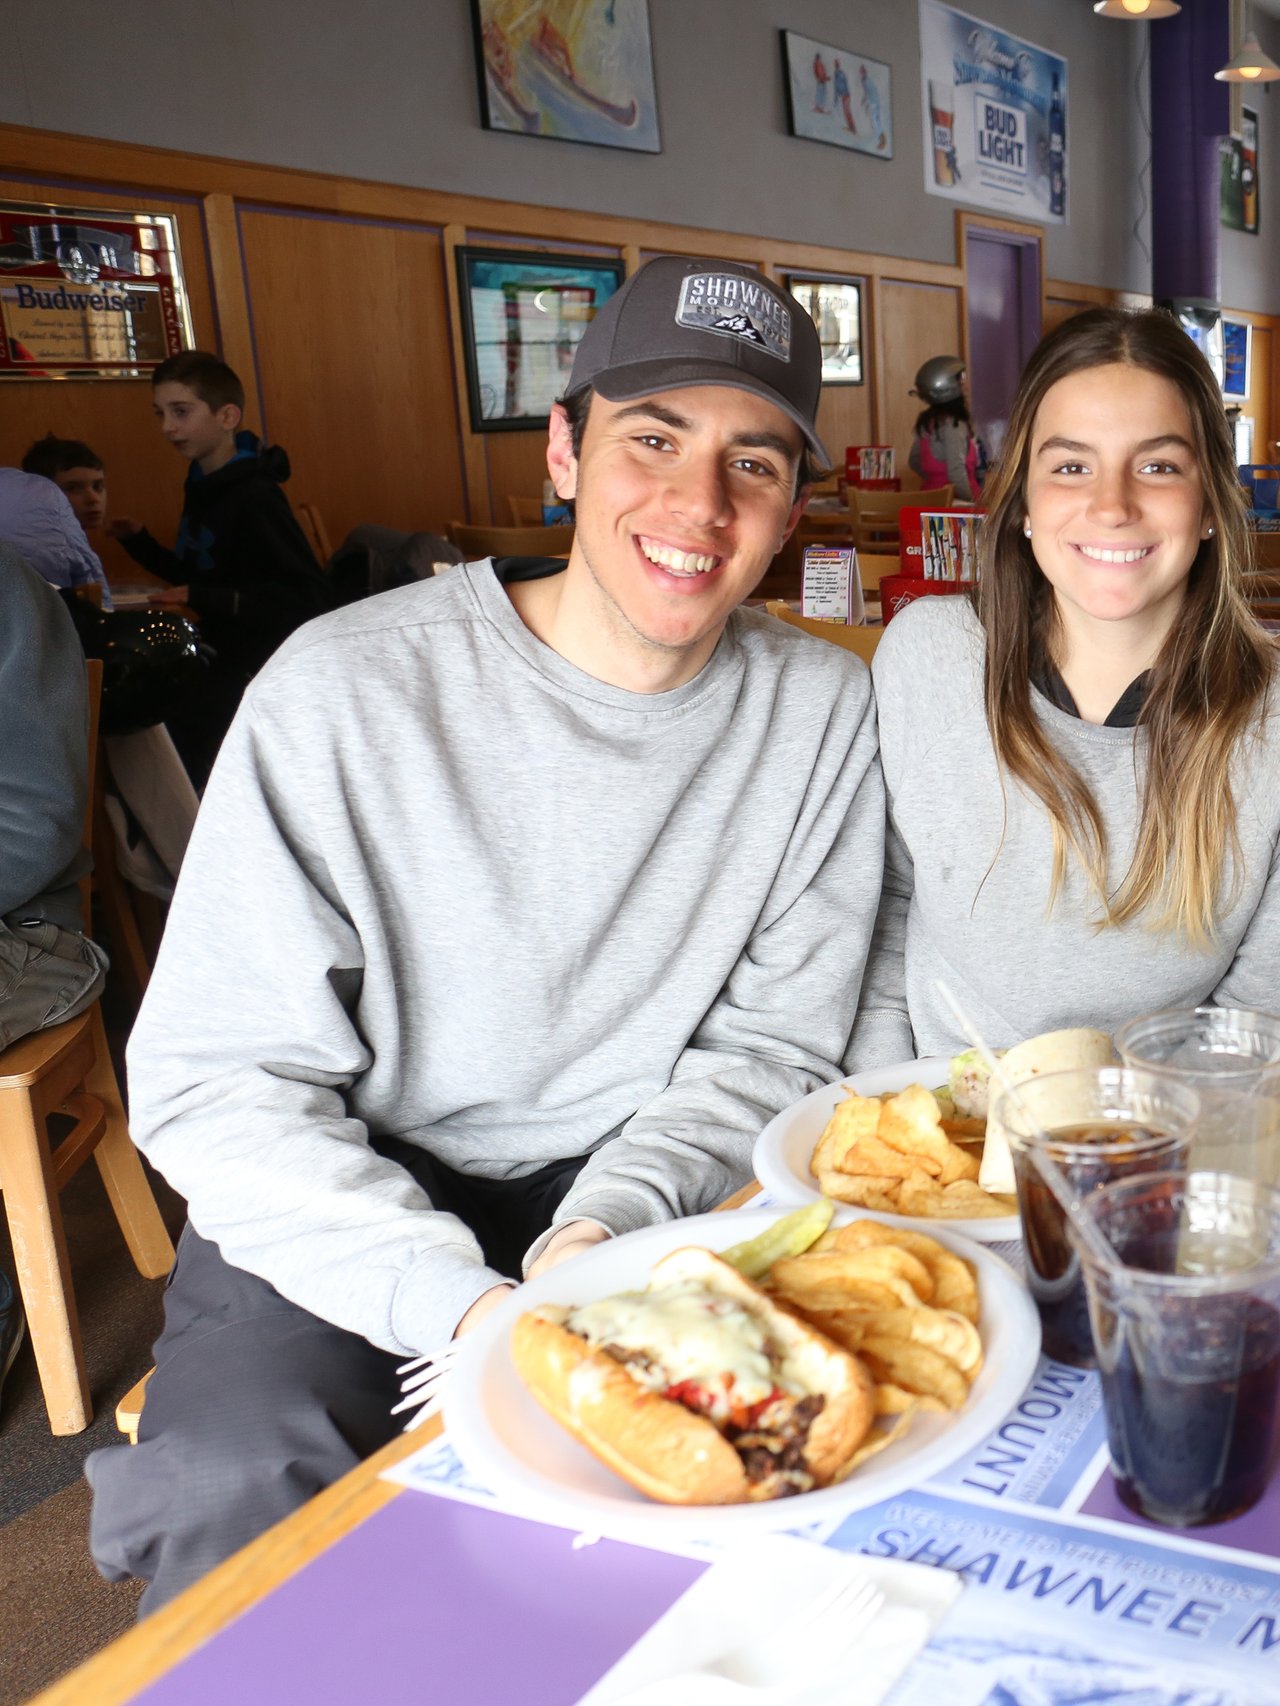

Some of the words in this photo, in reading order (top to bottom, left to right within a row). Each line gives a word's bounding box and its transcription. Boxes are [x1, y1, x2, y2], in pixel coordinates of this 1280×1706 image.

[985, 104, 1017, 137] BUD
[979, 130, 1024, 167] LIGHT
[15, 284, 147, 313] Budweiser
[691, 277, 789, 333] SHAWNEE
[885, 1504, 1025, 1545] WELCOME
[1023, 1532, 1062, 1556] TO
[1062, 1540, 1118, 1571] THE
[864, 1528, 1226, 1637] SHAWNEE
